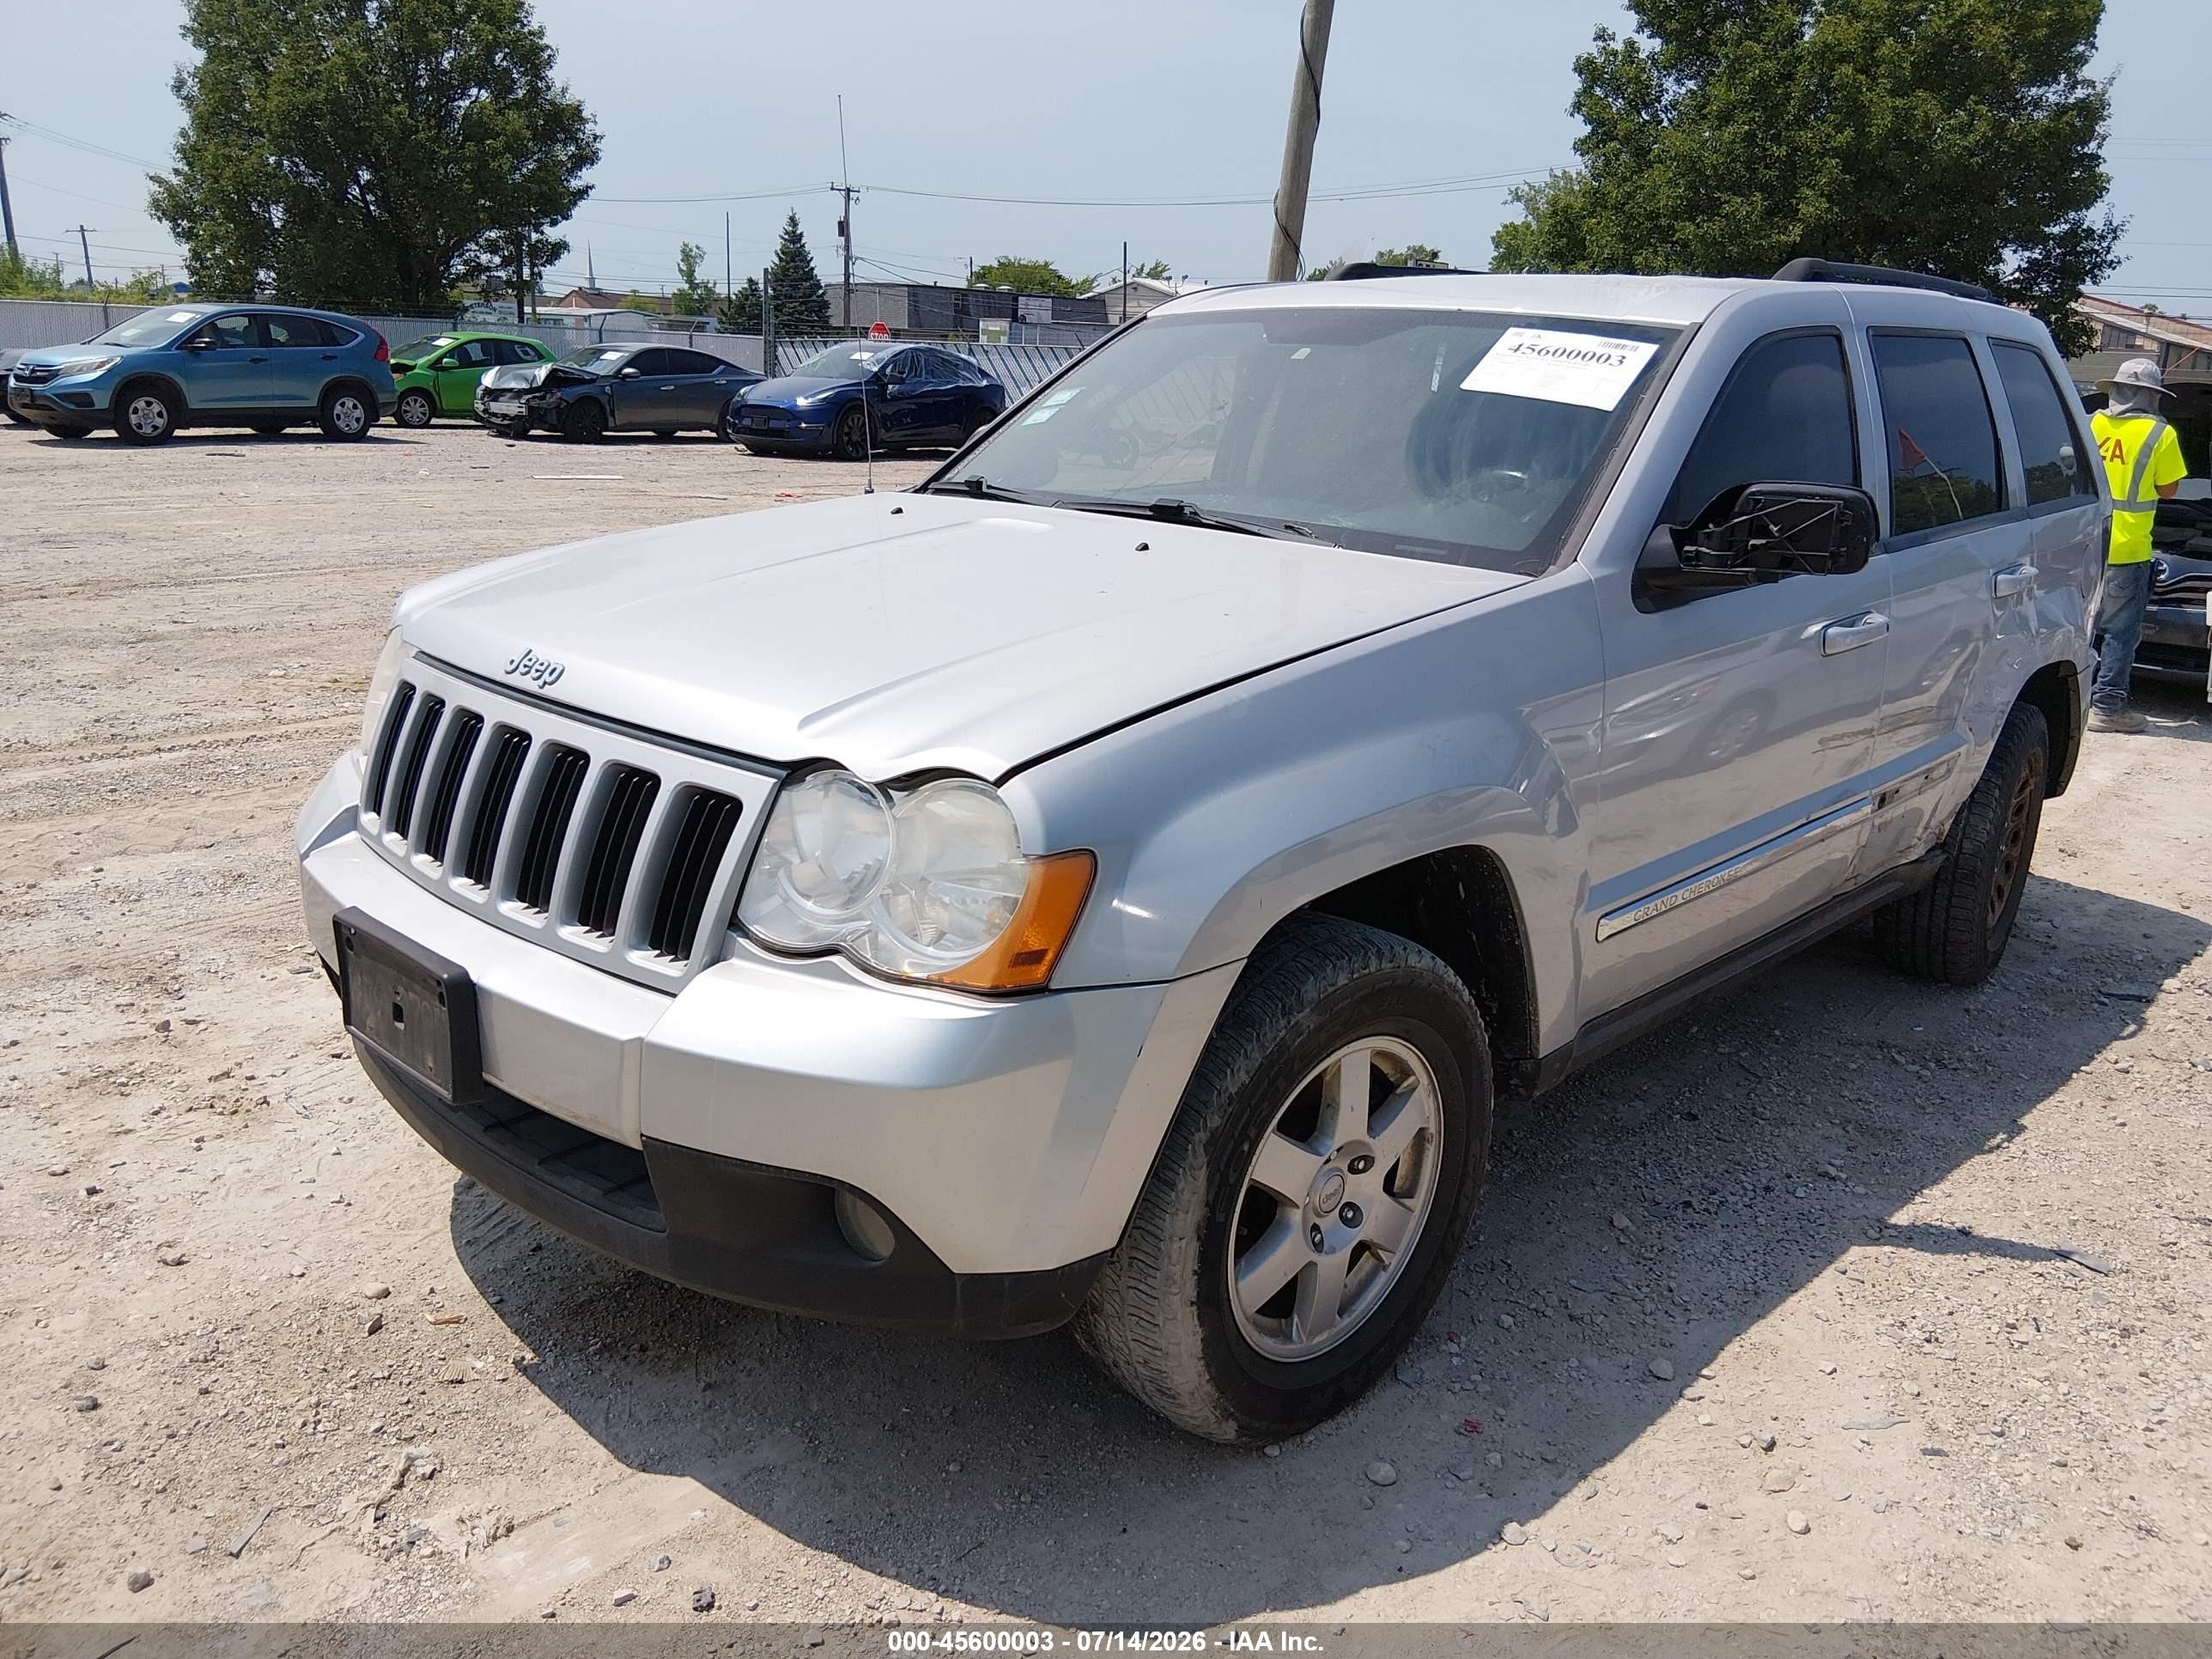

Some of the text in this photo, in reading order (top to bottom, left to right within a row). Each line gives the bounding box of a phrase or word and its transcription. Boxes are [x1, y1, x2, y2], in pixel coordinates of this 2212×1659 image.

[870, 332, 888, 341] STOP
[1507, 343, 1627, 367] 45600003
[504, 647, 566, 689] Jeep
[1633, 868, 1741, 922] GRAND CHEROKEE
